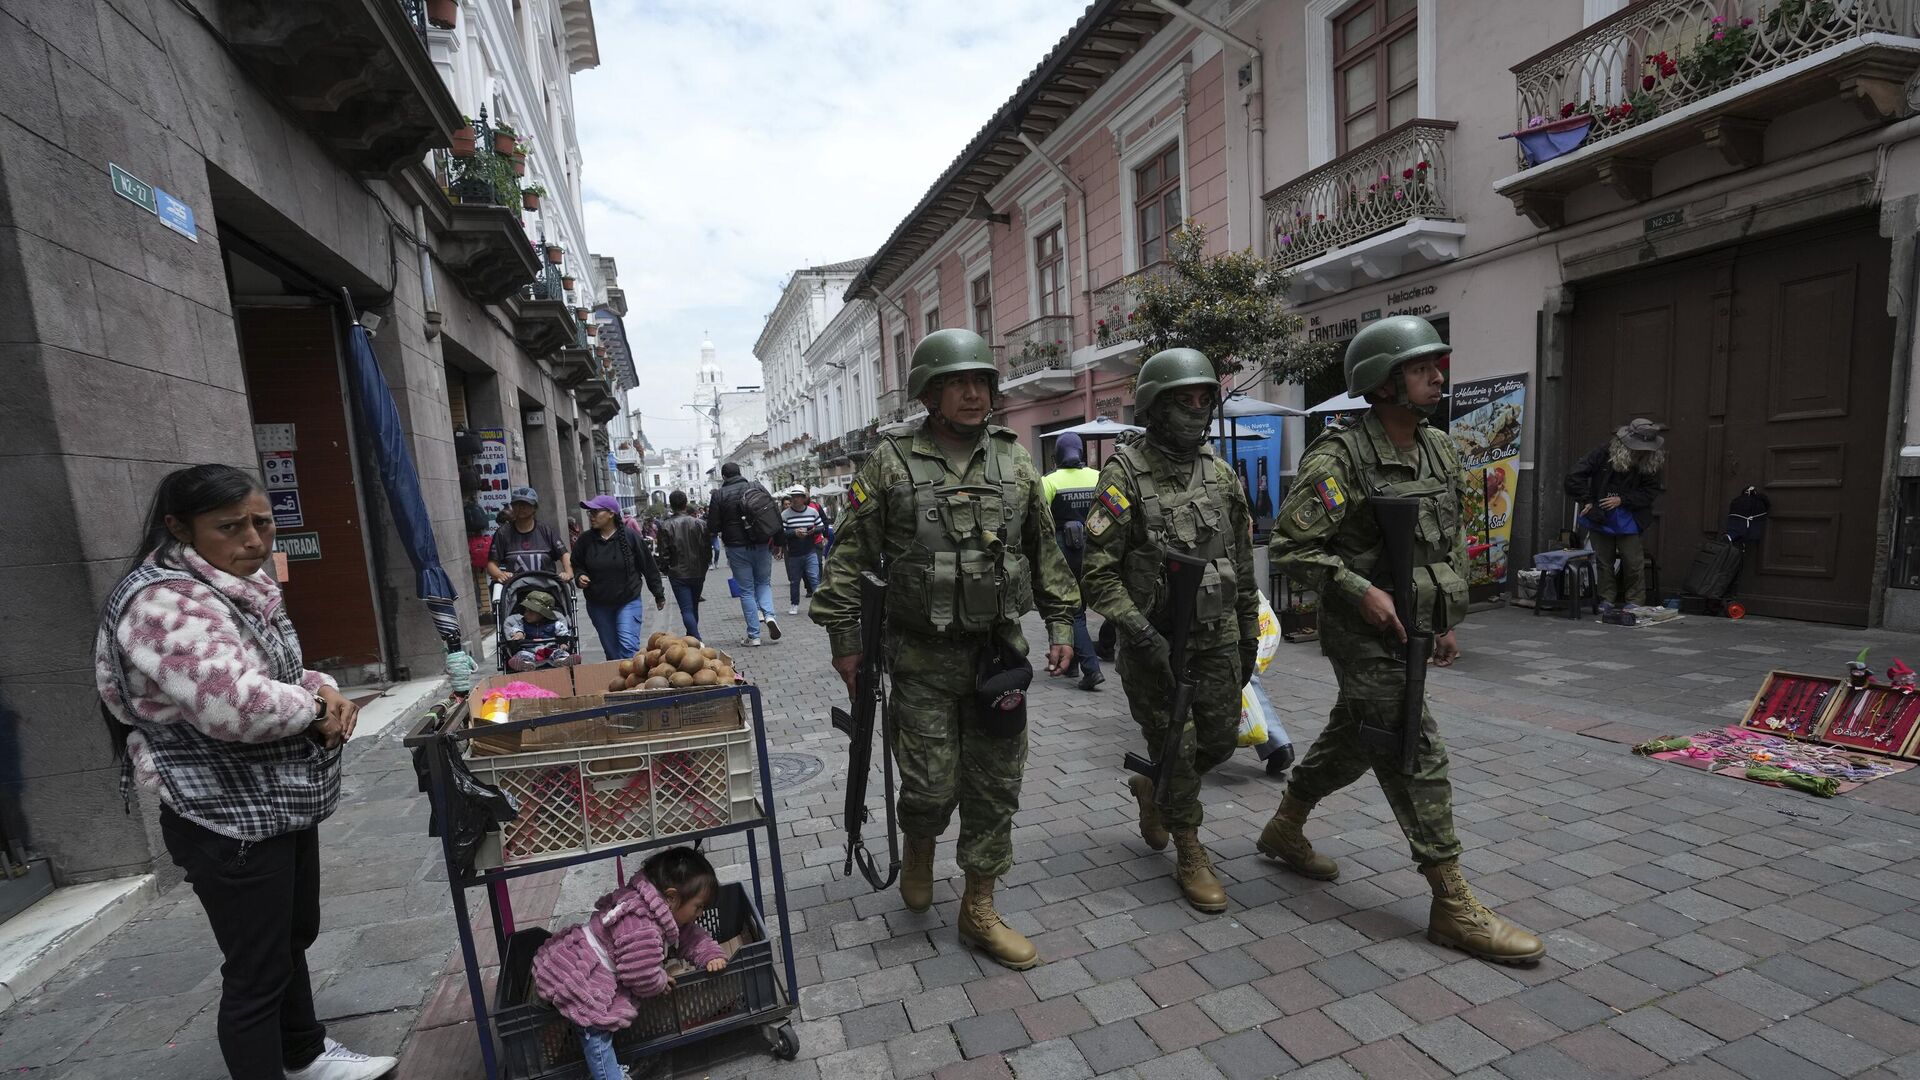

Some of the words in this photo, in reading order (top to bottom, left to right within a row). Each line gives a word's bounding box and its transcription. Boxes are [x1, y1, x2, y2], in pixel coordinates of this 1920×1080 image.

[120, 174, 147, 203] N2-27
[1310, 315, 1321, 326] DE
[1308, 318, 1358, 344] CANTUÑA
[1480, 450, 1490, 463] de
[1491, 444, 1517, 461] Dulce
[483, 493, 507, 501] BOLSOS
[1490, 514, 1506, 529] Sal
[277, 537, 319, 556] ENTRADA
